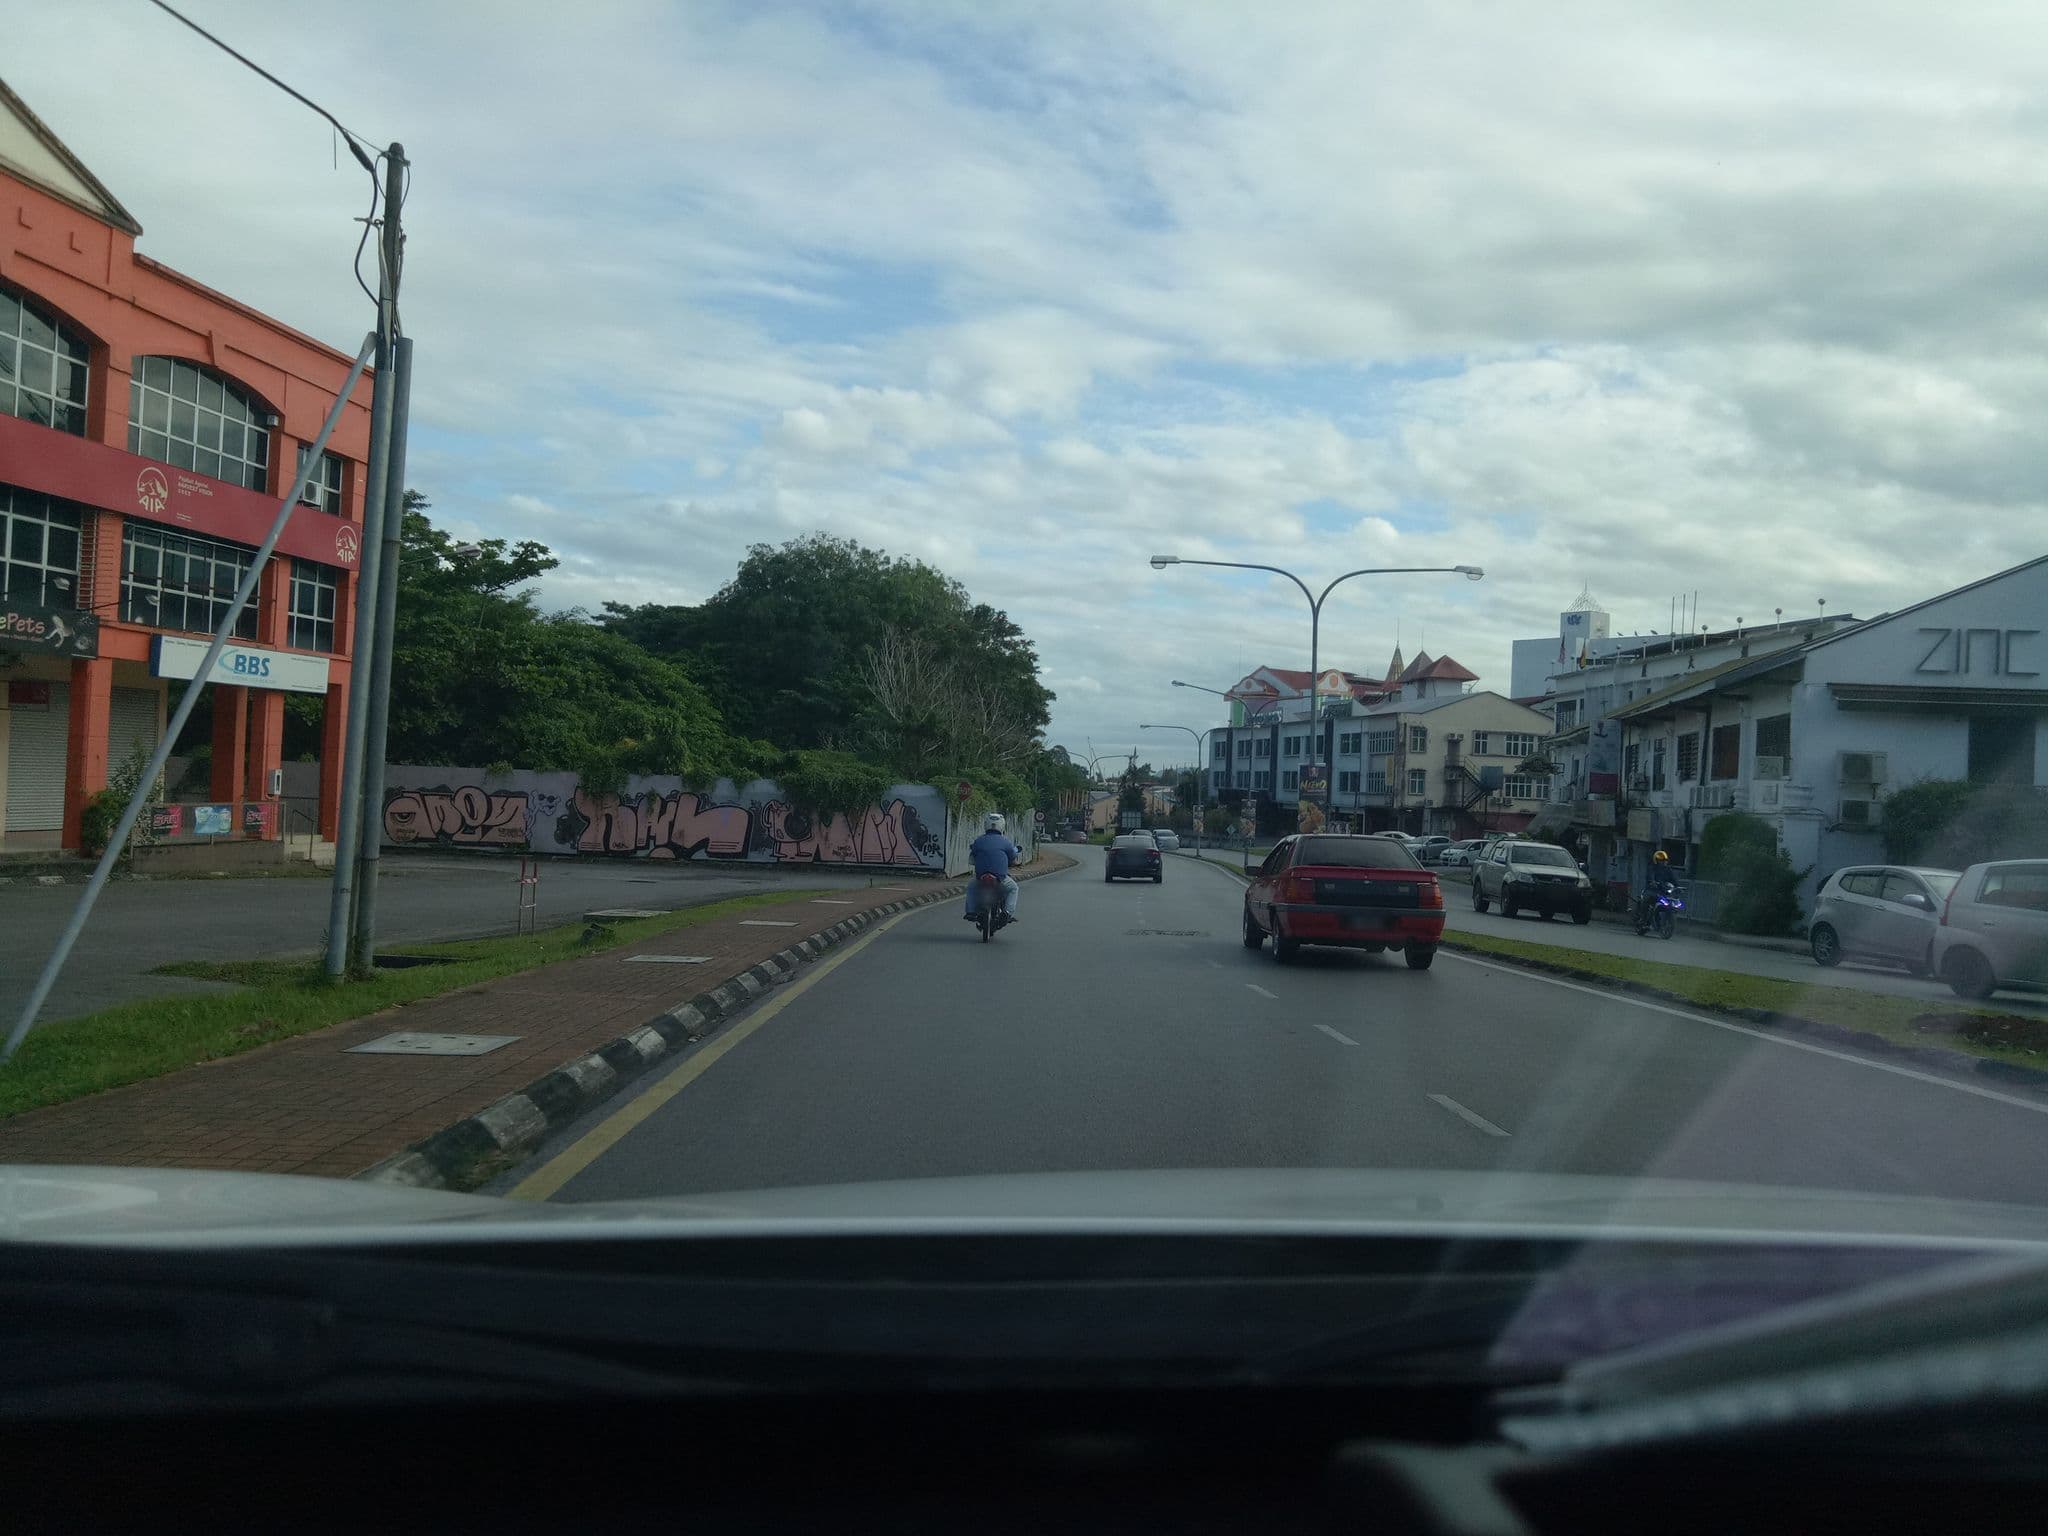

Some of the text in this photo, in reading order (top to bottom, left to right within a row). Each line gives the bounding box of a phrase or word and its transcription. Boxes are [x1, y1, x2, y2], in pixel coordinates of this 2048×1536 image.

[138, 494, 166, 513] AIA
[337, 548, 356, 563] AIA
[233, 654, 271, 677] BBS
